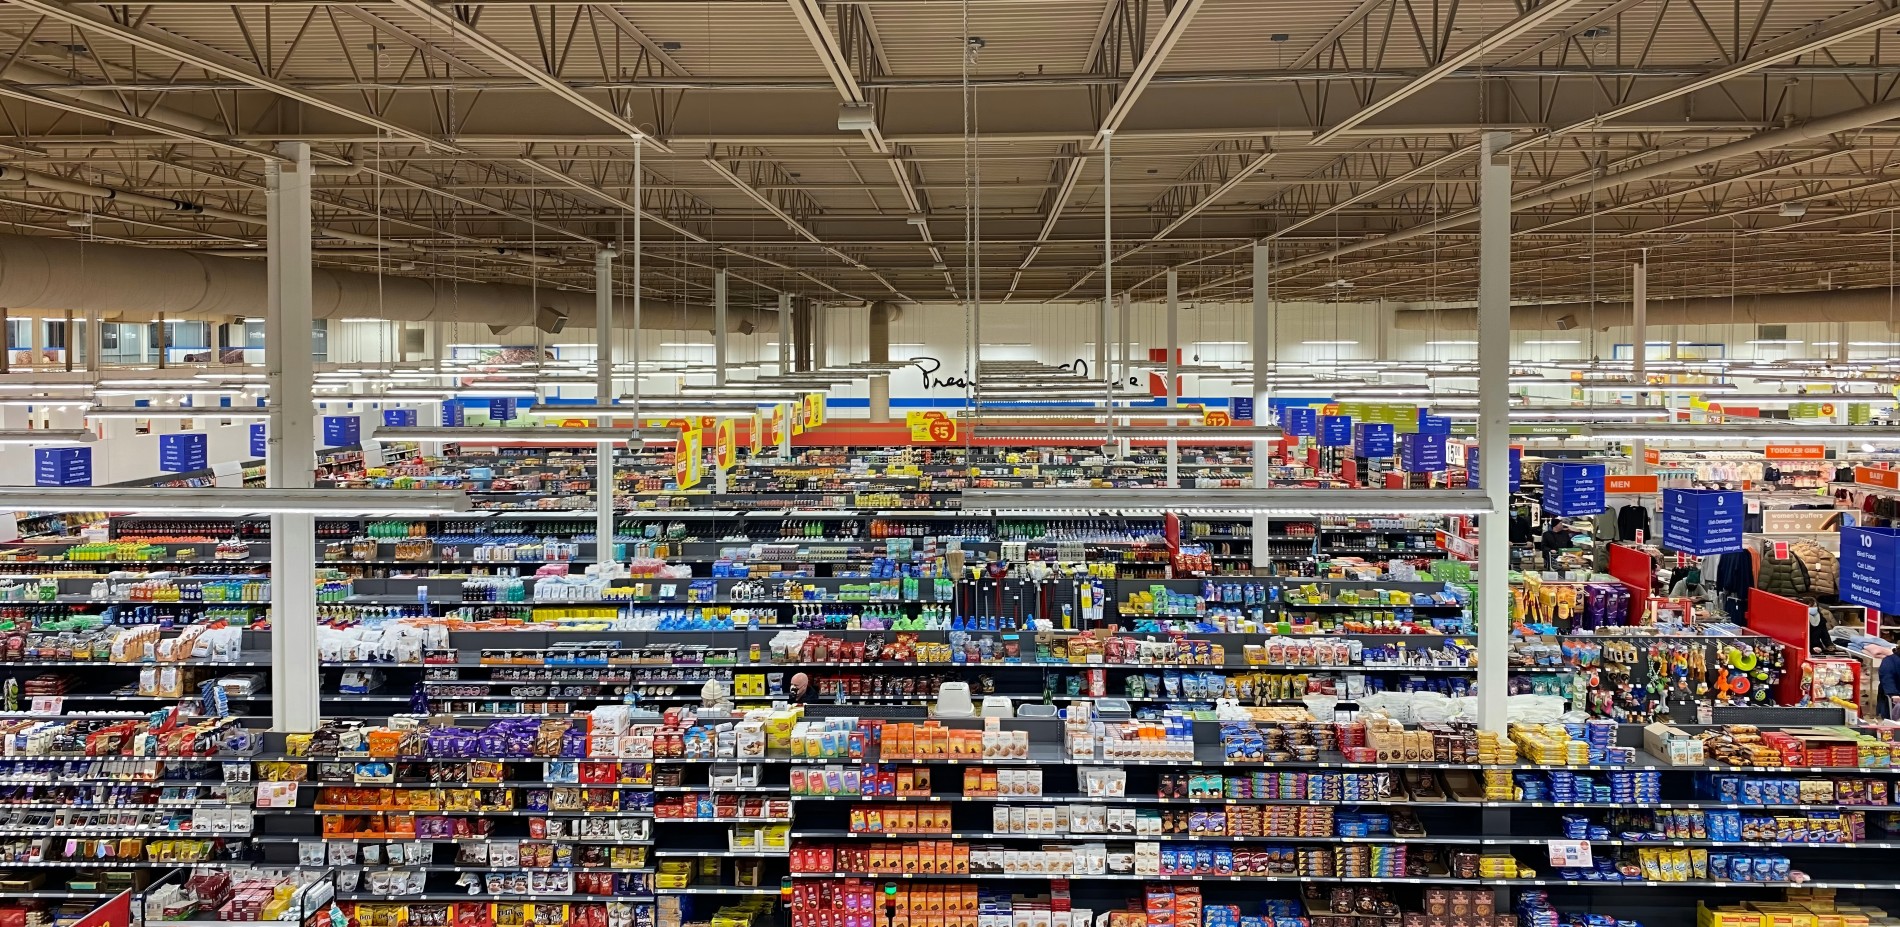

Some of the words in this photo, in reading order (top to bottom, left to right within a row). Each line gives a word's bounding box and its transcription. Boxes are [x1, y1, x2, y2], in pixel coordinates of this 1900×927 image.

[1207, 418, 1226, 426] $12
[934, 427, 948, 438] $5
[1448, 444, 1454, 462] 15
[1582, 468, 1587, 476] 8
[1870, 471, 1884, 480] BABY
[1678, 494, 1682, 504] 9
[1718, 496, 1724, 505] 9
[1860, 534, 1872, 548] 10
[1865, 564, 1875, 572] Litter
[1860, 574, 1869, 582] Dog
[1870, 588, 1880, 596] Food
[1859, 597, 1881, 608] Accessories
